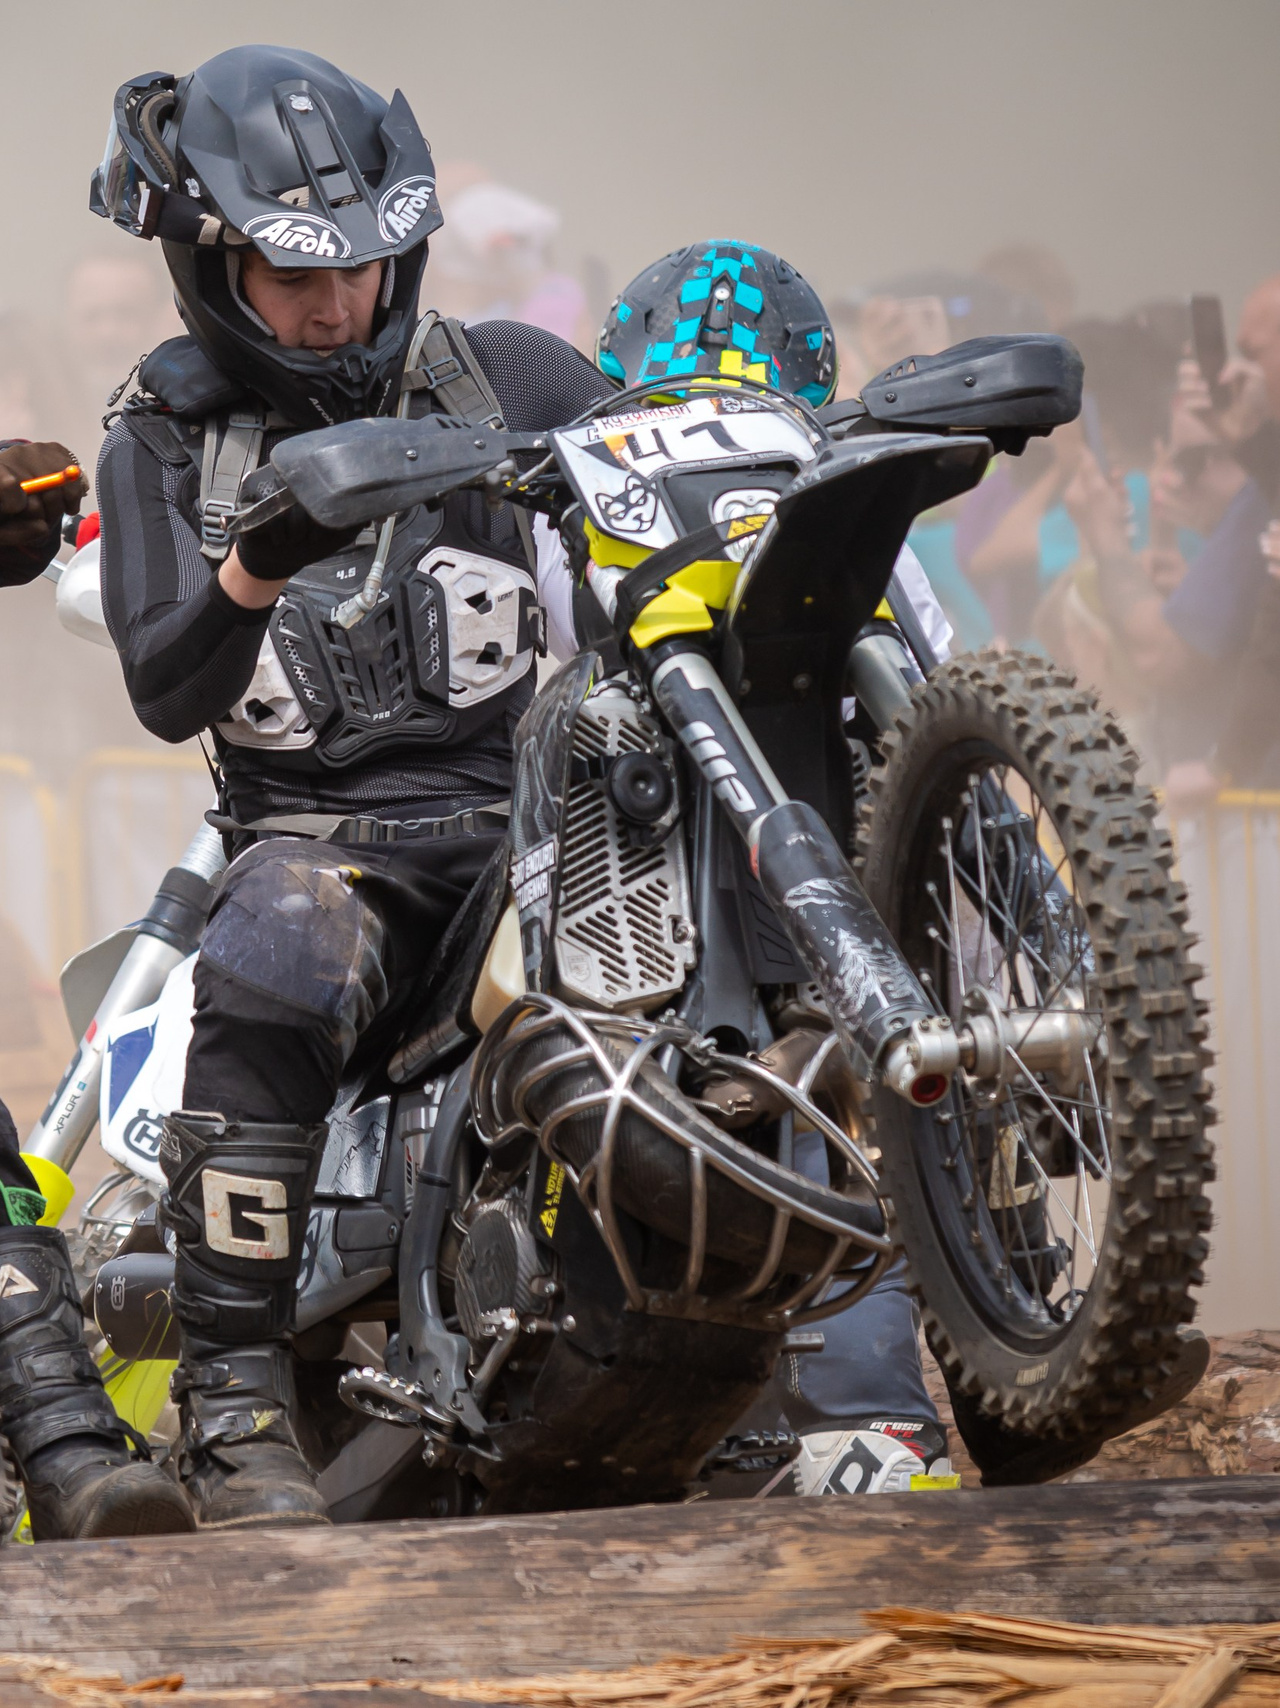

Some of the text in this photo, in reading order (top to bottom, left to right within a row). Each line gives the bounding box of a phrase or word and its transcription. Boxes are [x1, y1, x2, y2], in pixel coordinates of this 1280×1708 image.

[385, 186, 434, 239] Airoh
[252, 218, 336, 257] Airoh
[372, 710, 391, 721] PRO
[53, 1093, 81, 1135] XPLOR
[201, 1168, 290, 1260] G
